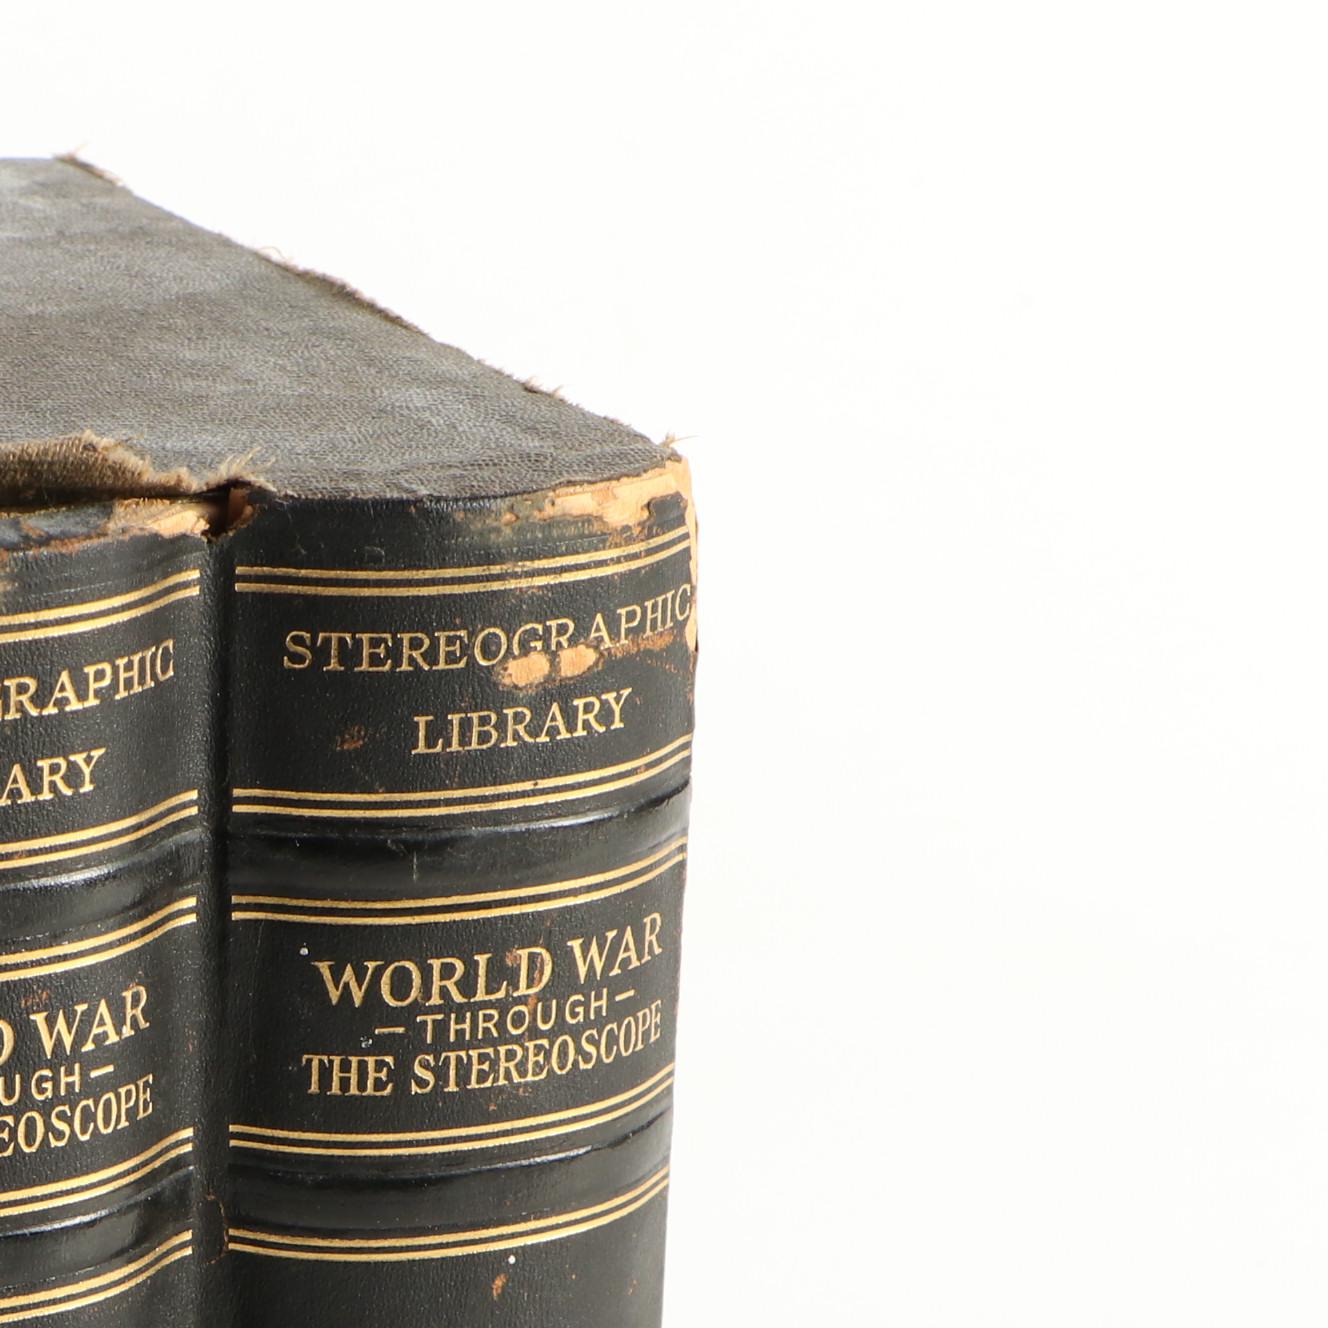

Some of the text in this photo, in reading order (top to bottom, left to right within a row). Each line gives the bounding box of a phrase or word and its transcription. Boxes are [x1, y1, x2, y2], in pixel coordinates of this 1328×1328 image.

[283, 583, 691, 673] STEREOGRAPHIC
[411, 687, 633, 755] LIBRARY
[312, 911, 663, 1009] WORLD WAR
[29, 983, 151, 1060] WAR
[301, 999, 663, 1096] THE STEREOSCOPE
